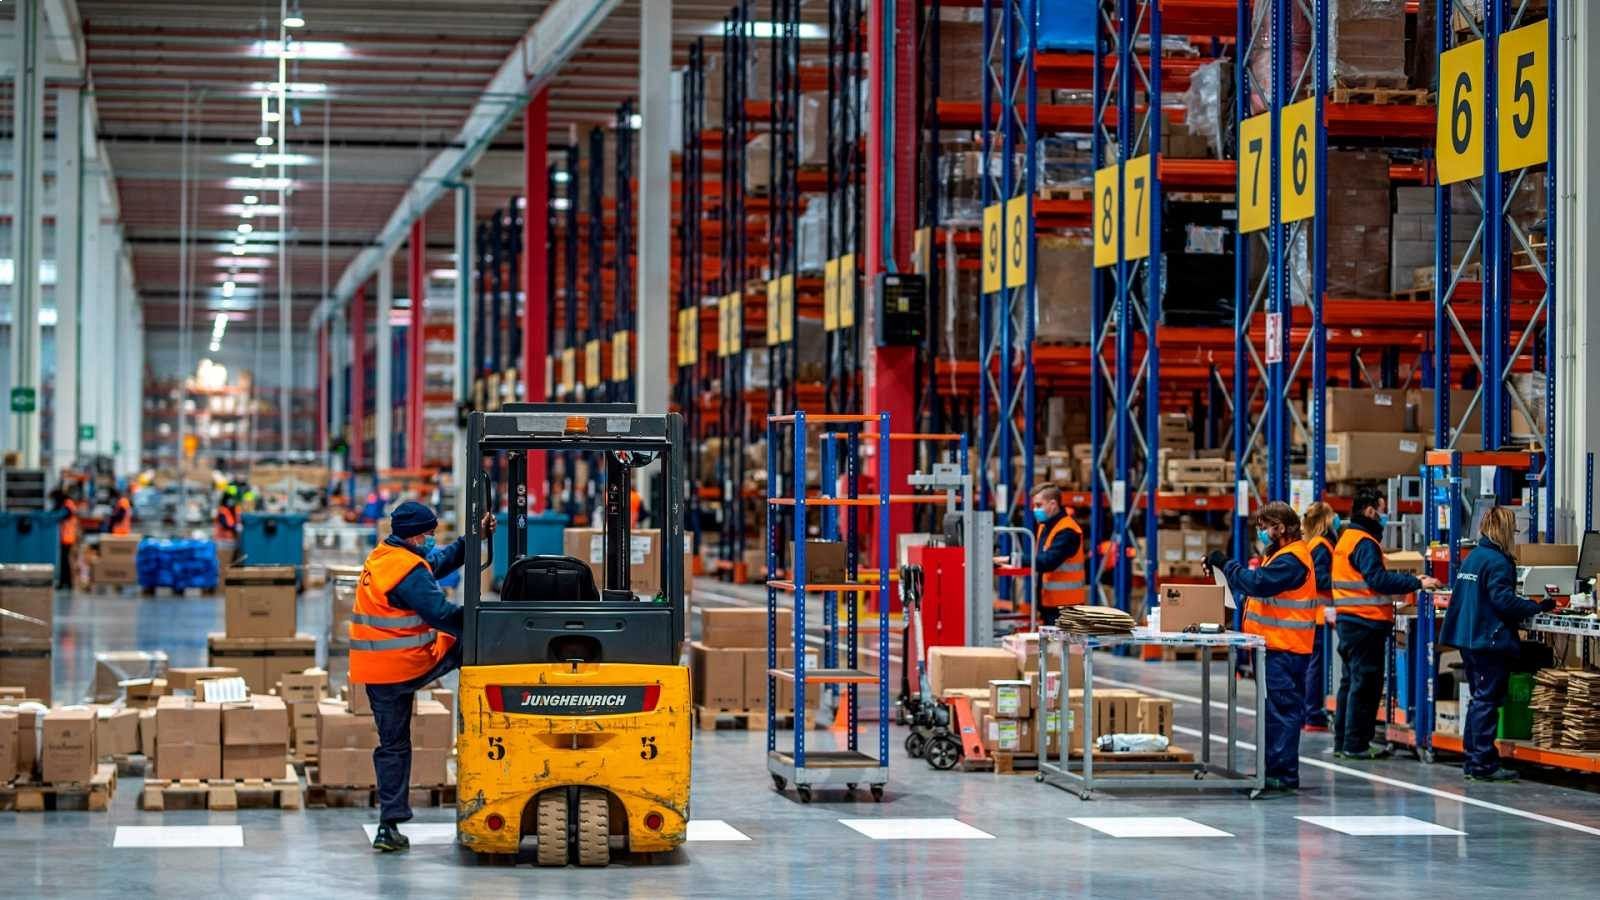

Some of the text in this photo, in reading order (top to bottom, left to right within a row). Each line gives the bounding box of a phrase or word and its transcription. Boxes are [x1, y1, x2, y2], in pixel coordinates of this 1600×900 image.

[1452, 71, 1472, 155] 6
[1513, 51, 1535, 139] 5
[1249, 138, 1262, 206] 7
[1293, 123, 1308, 196] 6
[1102, 186, 1112, 246] 8
[1134, 176, 1145, 237] 7
[990, 223, 998, 274] 9
[1013, 215, 1022, 268] 8
[521, 692, 626, 706] JUNGHEINRICH
[487, 736, 505, 760] 5
[640, 736, 658, 760] 5
